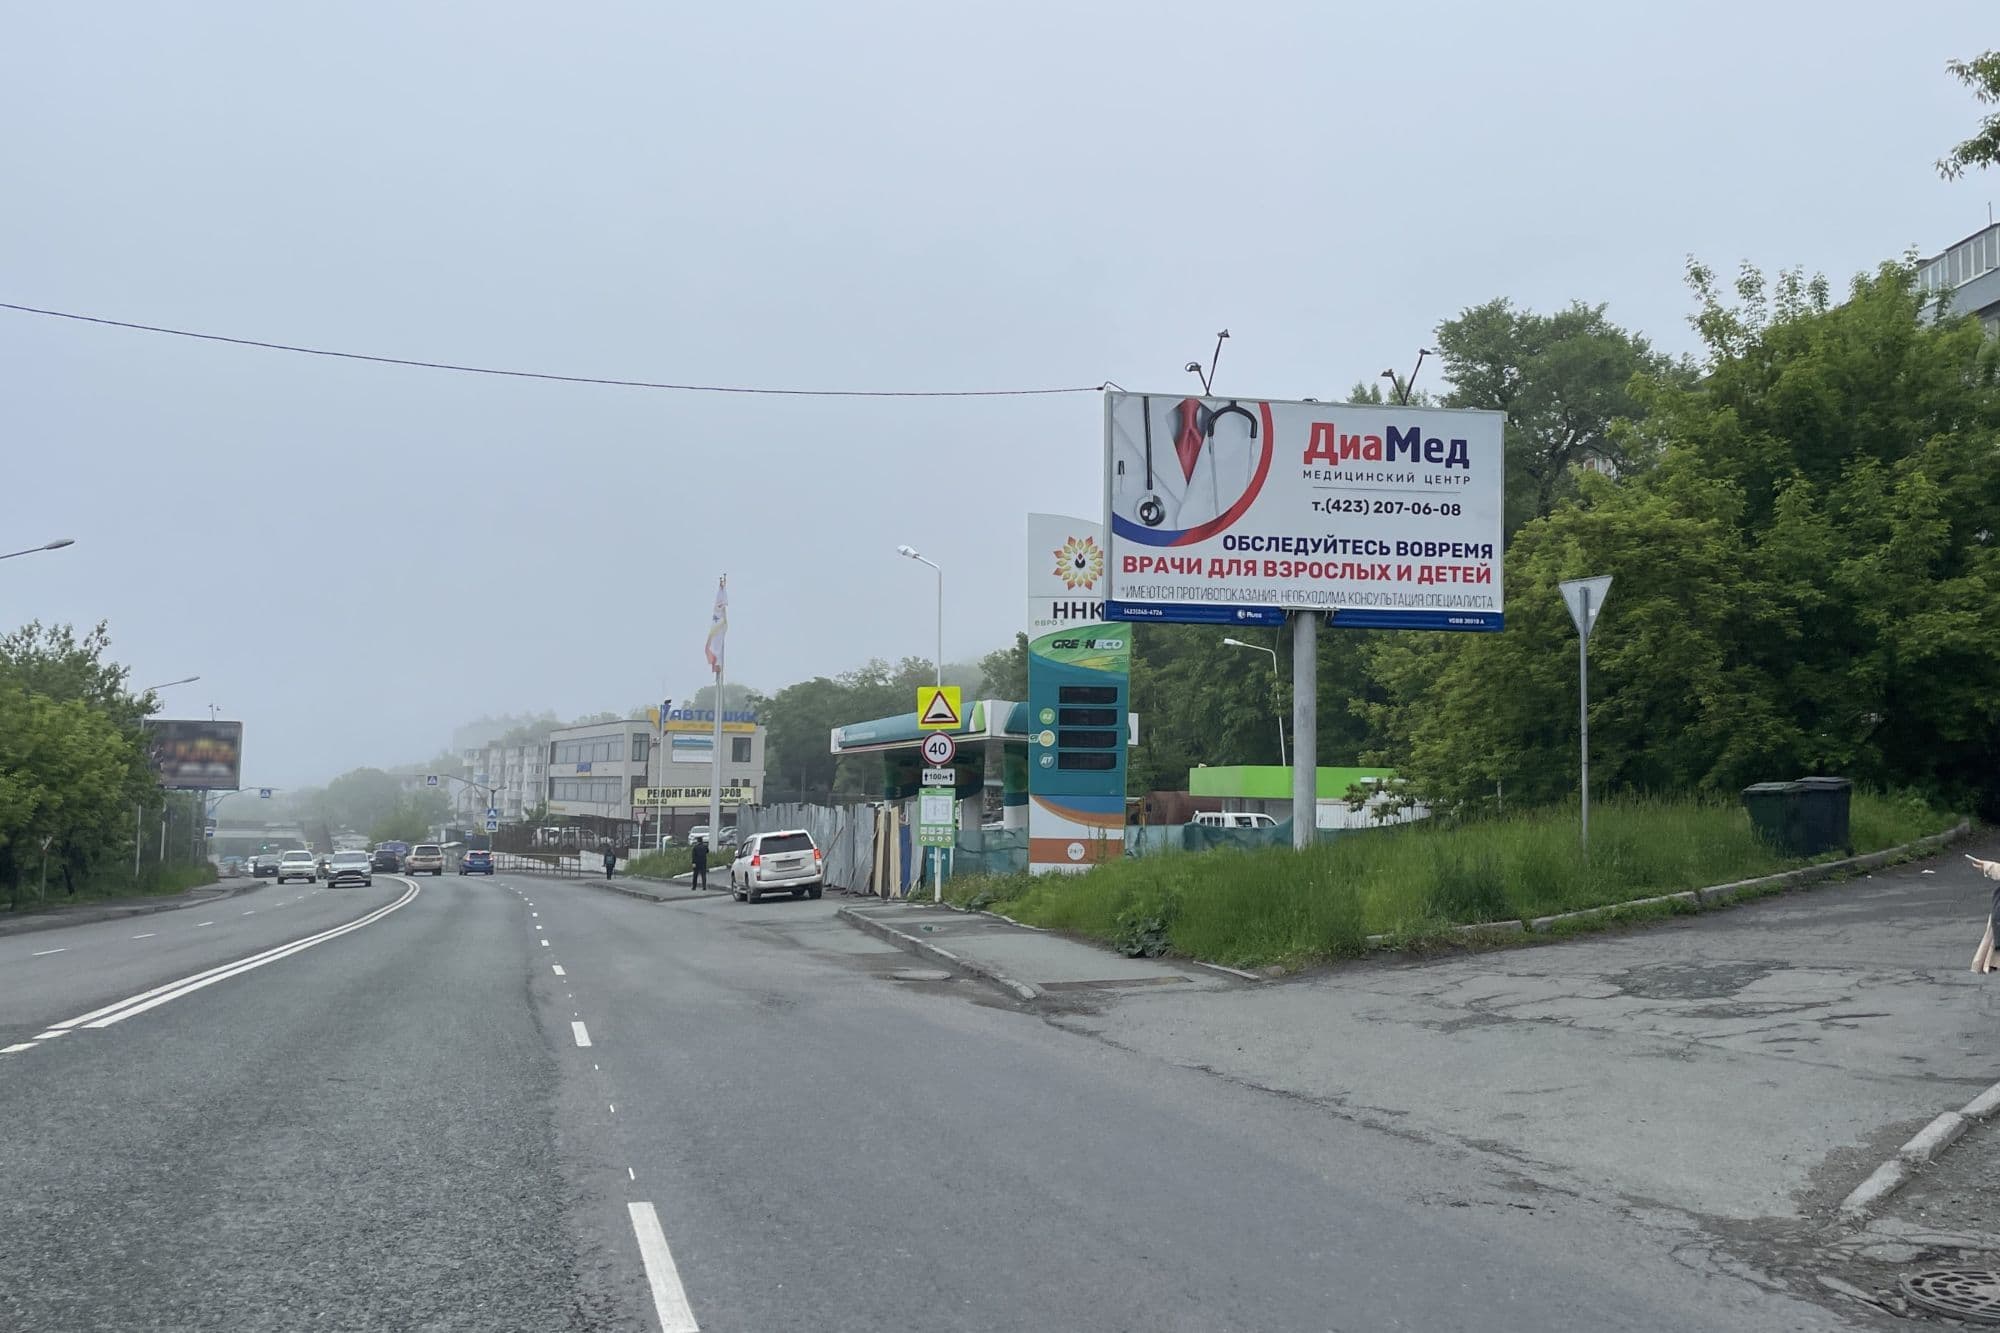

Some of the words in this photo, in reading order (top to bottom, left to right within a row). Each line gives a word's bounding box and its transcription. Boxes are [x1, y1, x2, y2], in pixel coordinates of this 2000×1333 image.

[1303, 422, 1470, 470] ДиаМед
[1303, 470, 1415, 483] МЕДИЦИНСКИЙ
[1424, 475, 1471, 485] ЦЕНТР
[1312, 498, 1370, 515] т.(423)
[1373, 501, 1461, 516] 207-06-08
[1223, 534, 1391, 556] ОБСЛЕДУЙТЕСЬ
[1396, 541, 1493, 559] ВОВРЕМЯ
[1123, 556, 1202, 575] ВРАЧИ
[1208, 558, 1257, 578] ДЛЯ
[1263, 560, 1391, 581] ВЗРОСЛЫХ
[1397, 564, 1412, 581] И
[1417, 563, 1491, 585] ДЕТЕЙ
[1280, 590, 1346, 604] НЕОБХОДИМА
[1348, 592, 1424, 607] КОНСУЛЬТАЦИЯ
[1425, 594, 1493, 608] СПЕЦИАЛИСТА
[1053, 602, 1103, 619] ННК
[929, 743, 947, 755] 40
[647, 789, 683, 798] РЕМОНТ
